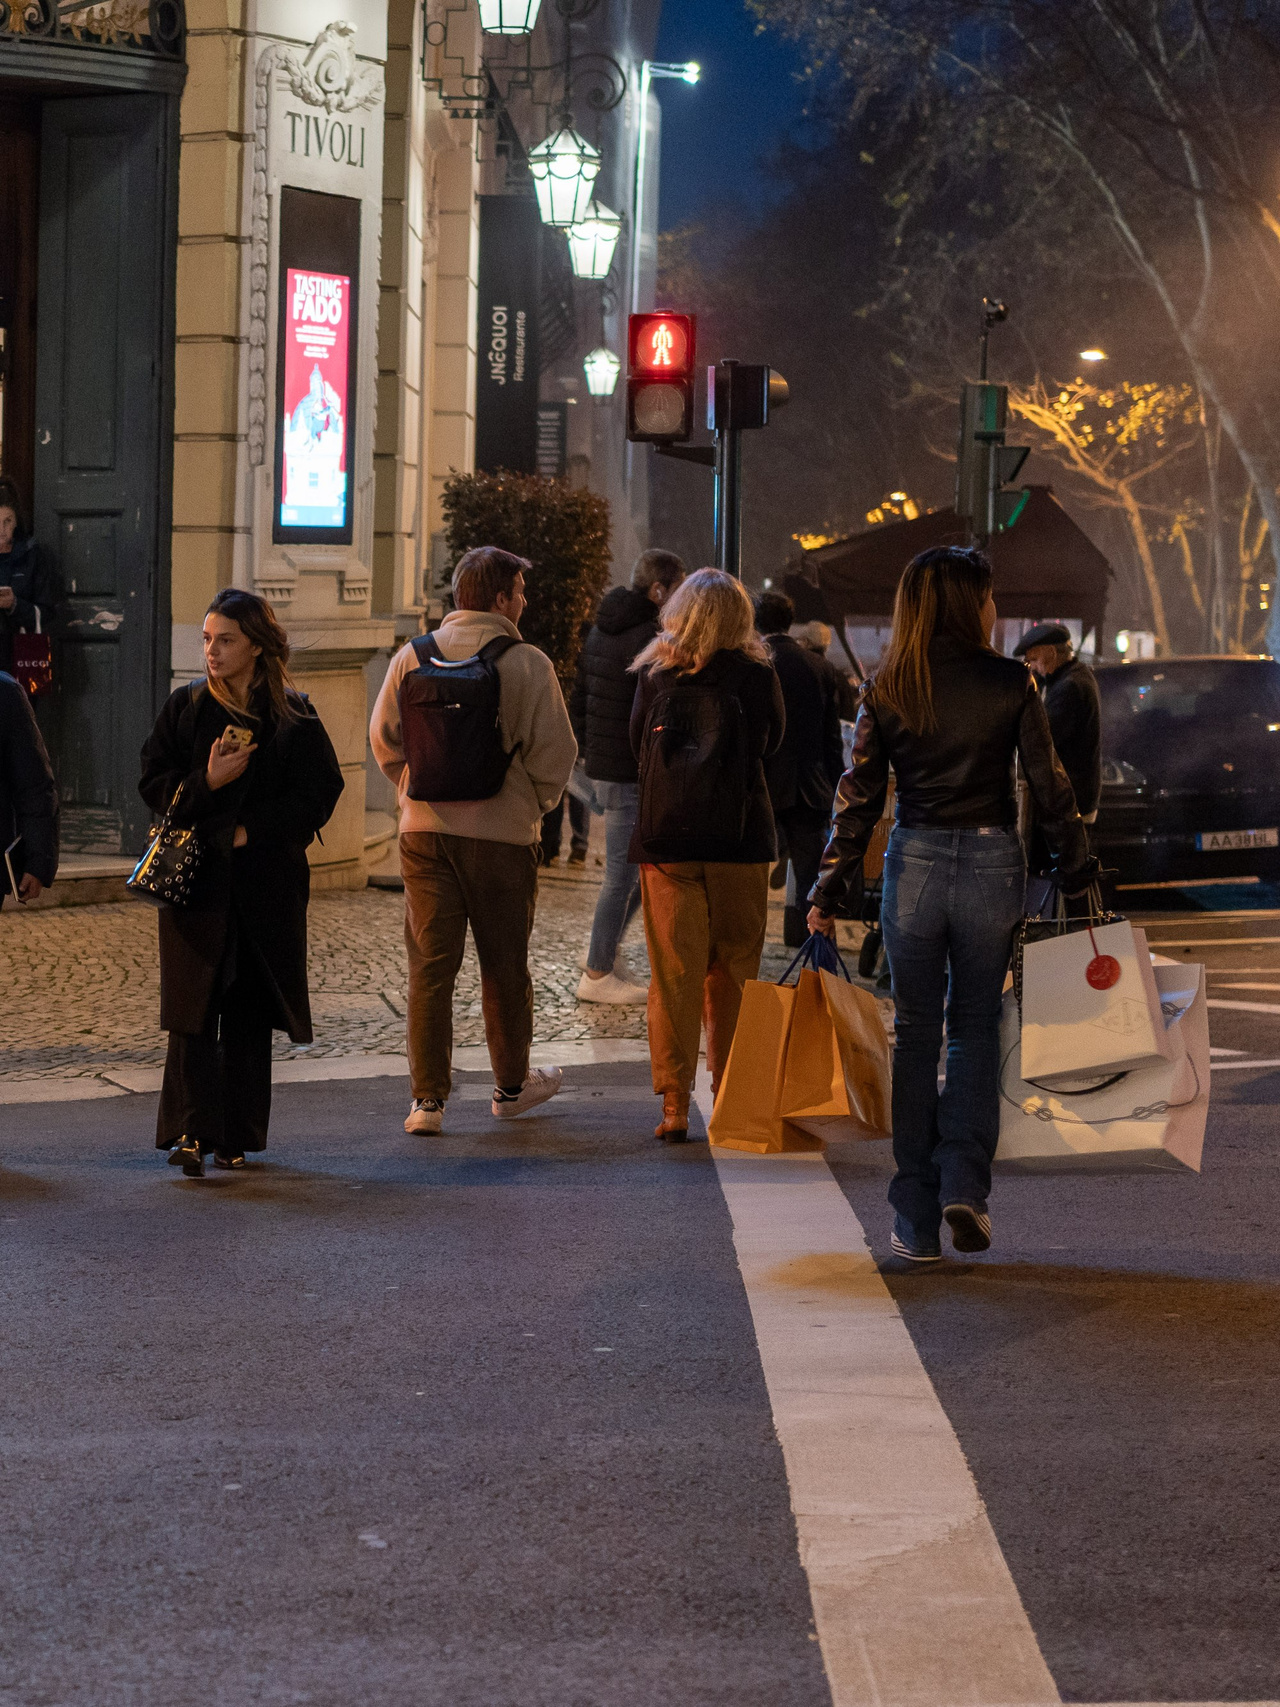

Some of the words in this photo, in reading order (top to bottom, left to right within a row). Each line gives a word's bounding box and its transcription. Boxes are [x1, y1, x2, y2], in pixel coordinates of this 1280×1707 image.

[284, 110, 365, 168] TIVOLI
[294, 274, 342, 299] TASTING
[293, 293, 342, 325] FADO
[513, 311, 526, 381] Restaurante
[17, 660, 50, 668] GUCCI
